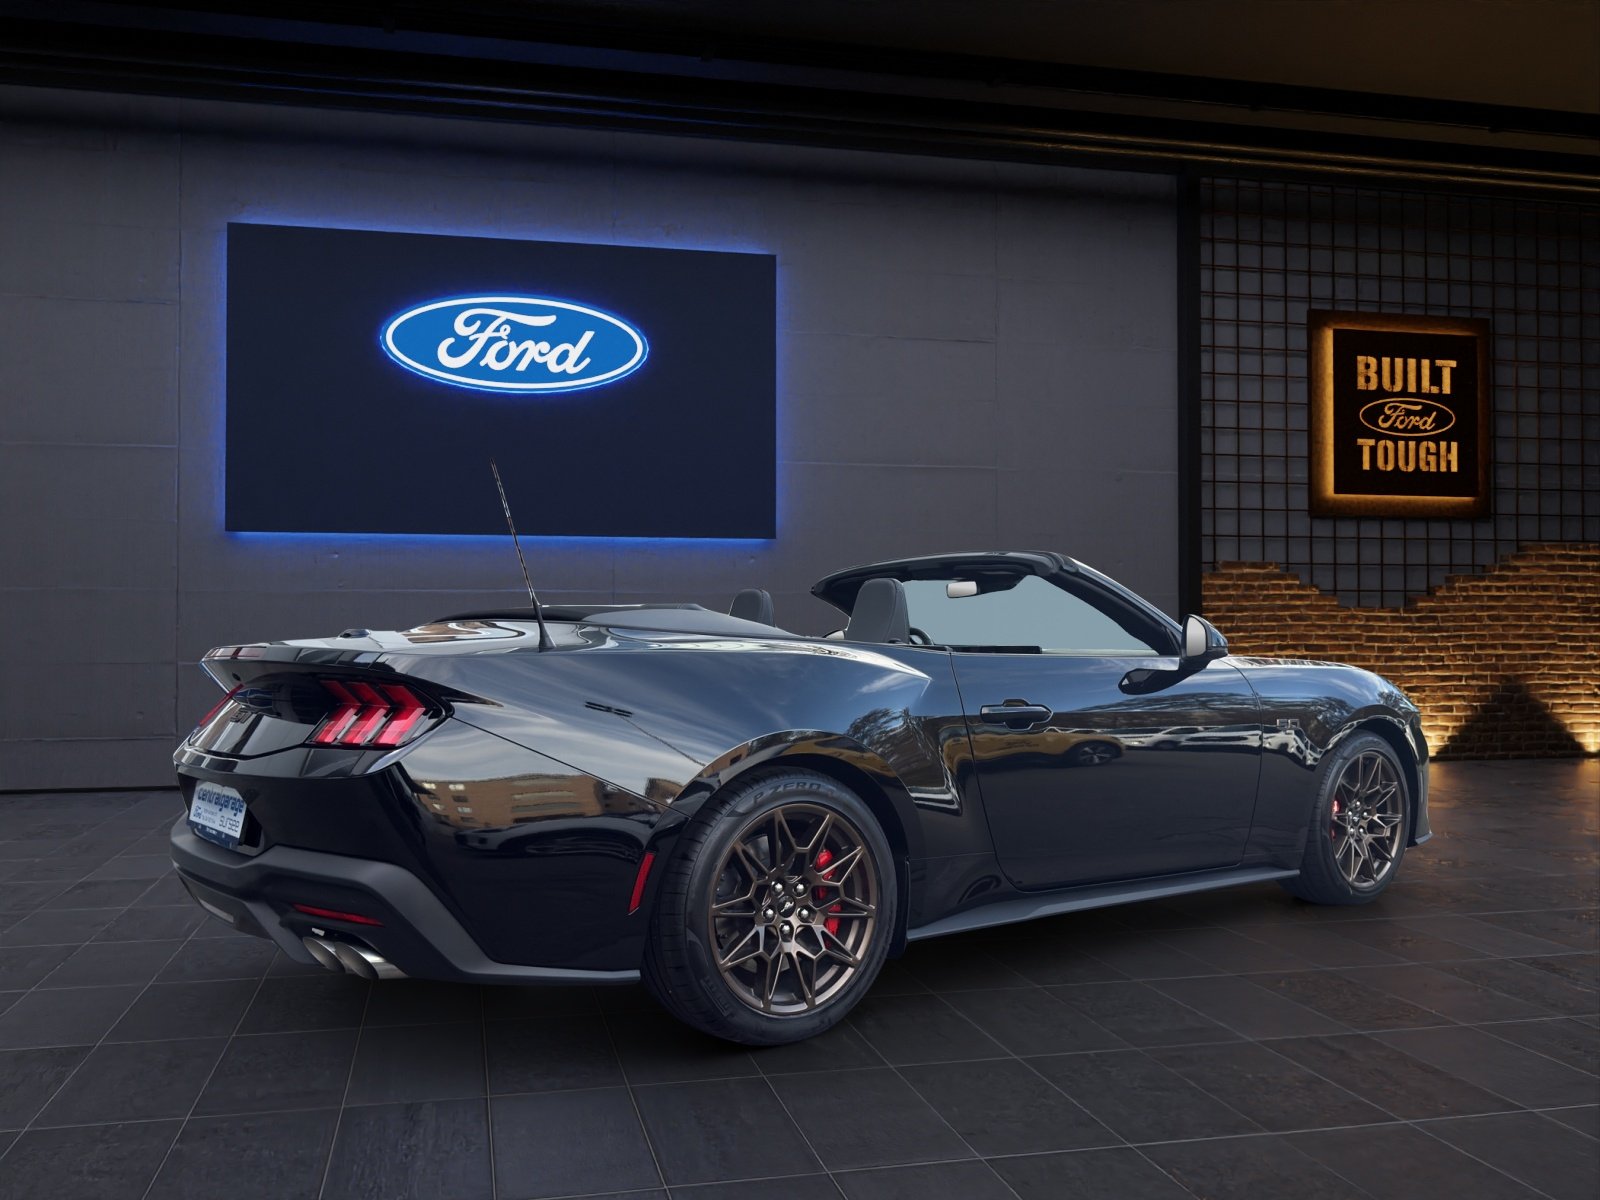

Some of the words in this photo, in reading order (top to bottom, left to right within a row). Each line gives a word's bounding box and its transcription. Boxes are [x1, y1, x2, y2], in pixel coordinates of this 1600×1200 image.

[437, 307, 595, 374] Ford
[1356, 355, 1457, 394] BUILT
[1378, 402, 1437, 431] Ford
[1356, 438, 1458, 473] TOUGH
[197, 787, 245, 818] centralgarage
[770, 781, 822, 796] ZERO
